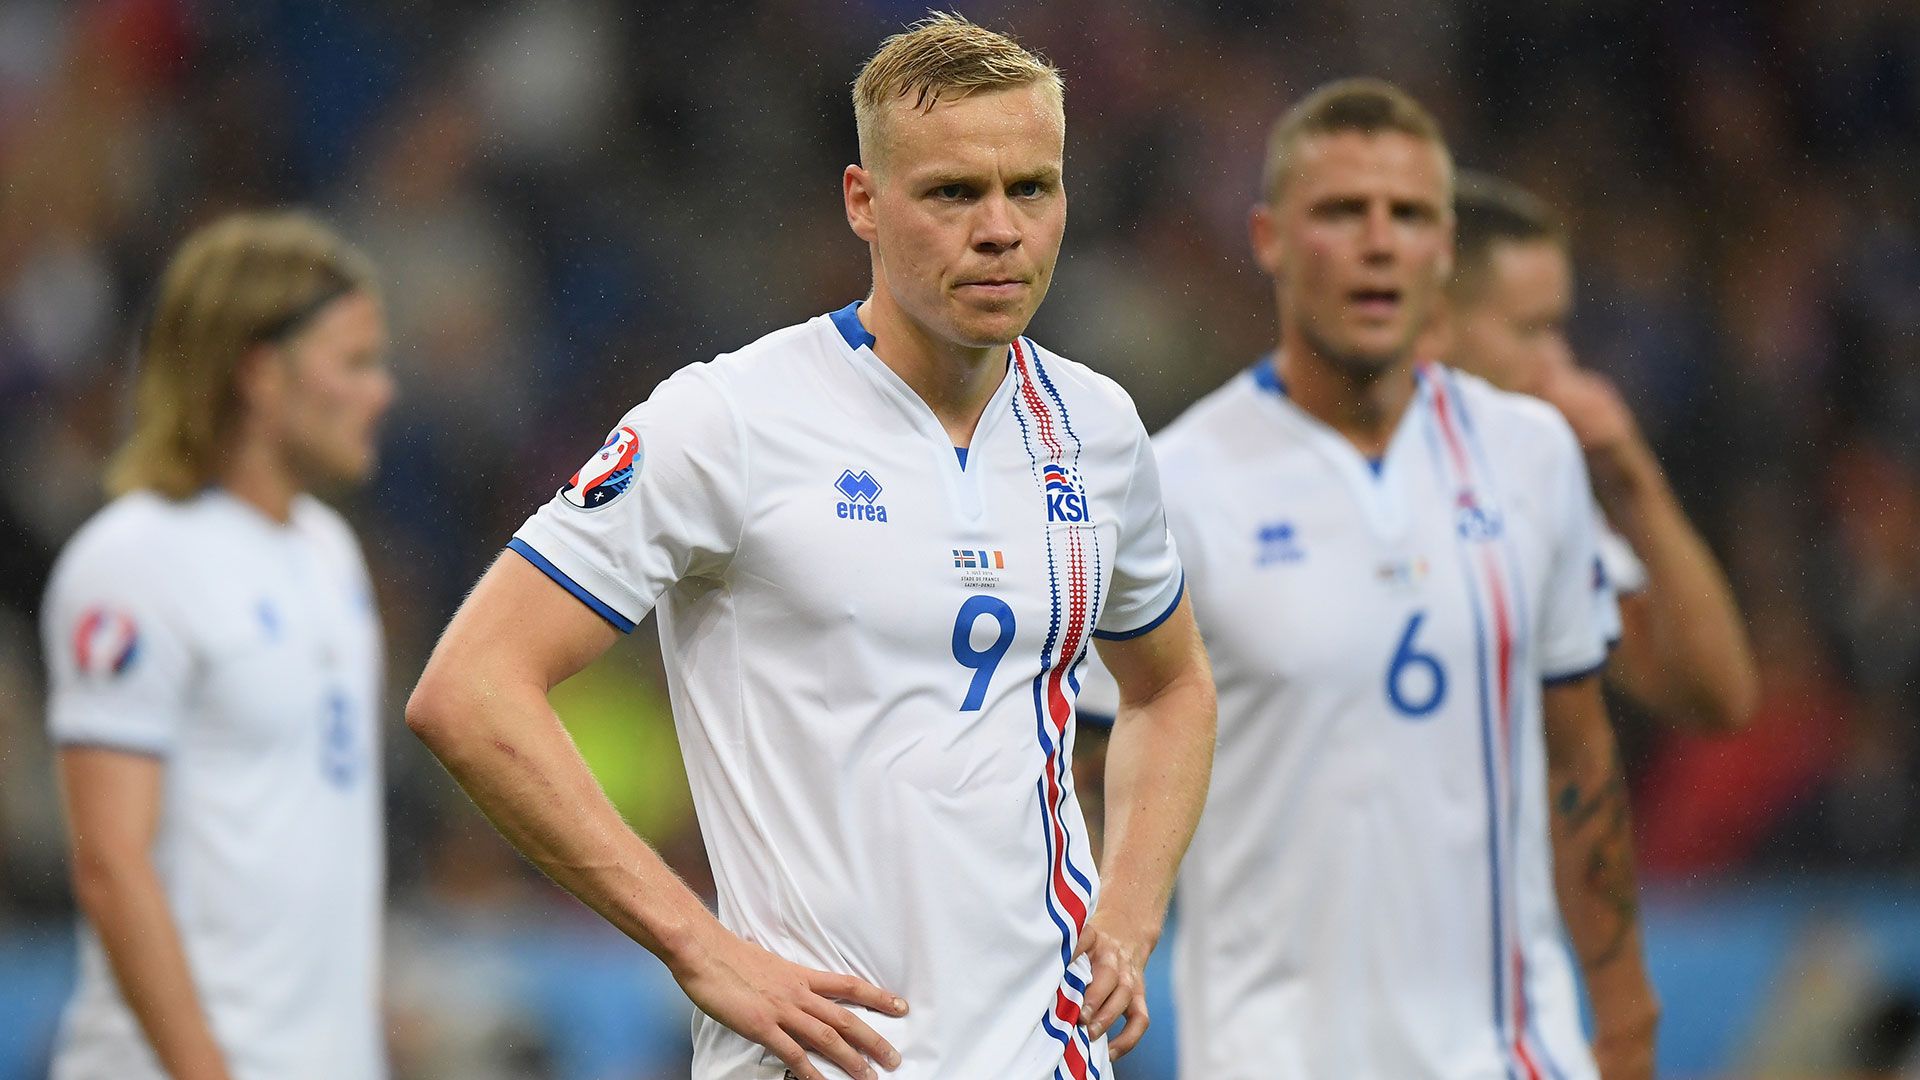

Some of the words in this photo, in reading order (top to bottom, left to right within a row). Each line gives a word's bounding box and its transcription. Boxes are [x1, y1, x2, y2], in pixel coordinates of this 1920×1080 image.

[836, 501, 888, 523] errea
[951, 594, 1016, 712] 9
[1385, 613, 1447, 717] 6
